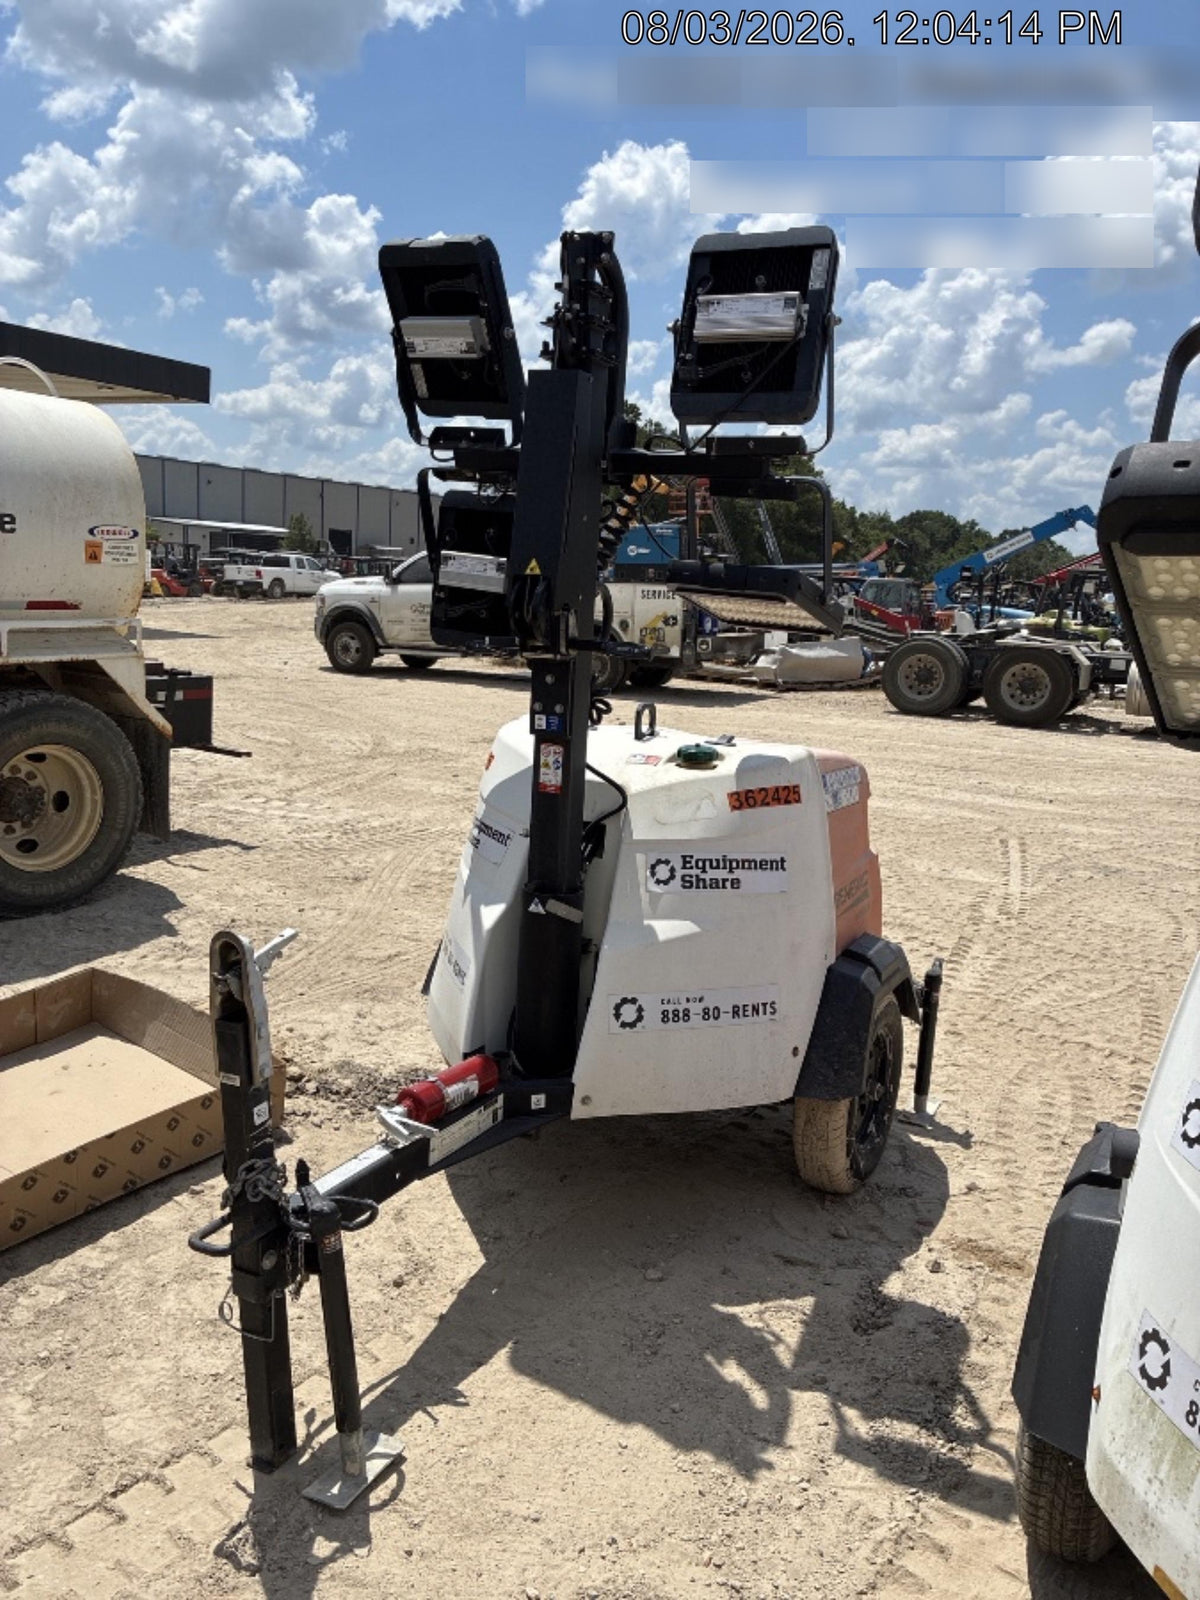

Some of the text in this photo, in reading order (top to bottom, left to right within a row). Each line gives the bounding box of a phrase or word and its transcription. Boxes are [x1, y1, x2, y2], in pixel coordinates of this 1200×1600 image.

[641, 588, 676, 600] SERVICE
[729, 785, 802, 810] 362425
[680, 854, 787, 874] Equipment
[680, 874, 741, 890] Share
[660, 1000, 777, 1024] 888-80-RENTS
